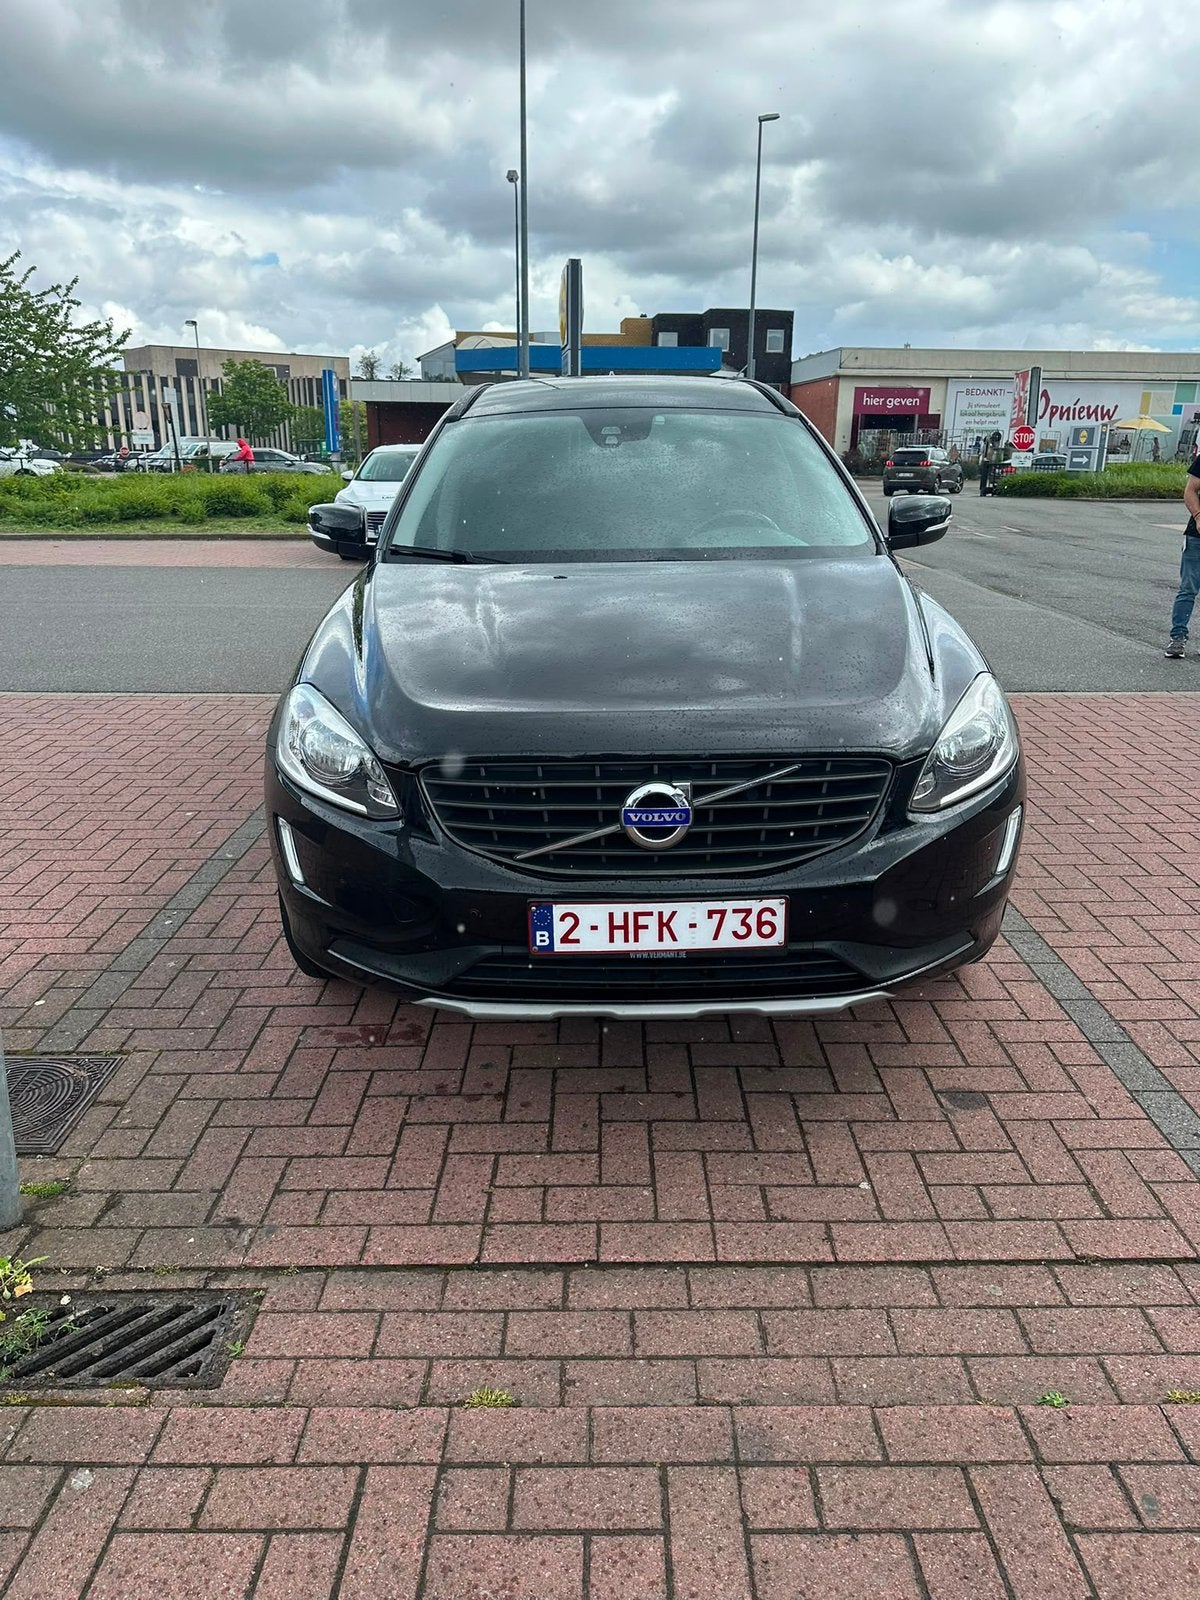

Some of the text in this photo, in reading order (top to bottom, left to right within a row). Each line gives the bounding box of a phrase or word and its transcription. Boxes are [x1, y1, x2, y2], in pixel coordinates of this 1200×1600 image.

[863, 393, 920, 409] hier geven
[1014, 433, 1035, 443] STOP
[627, 811, 687, 822] VOLVO
[536, 931, 550, 946] B
